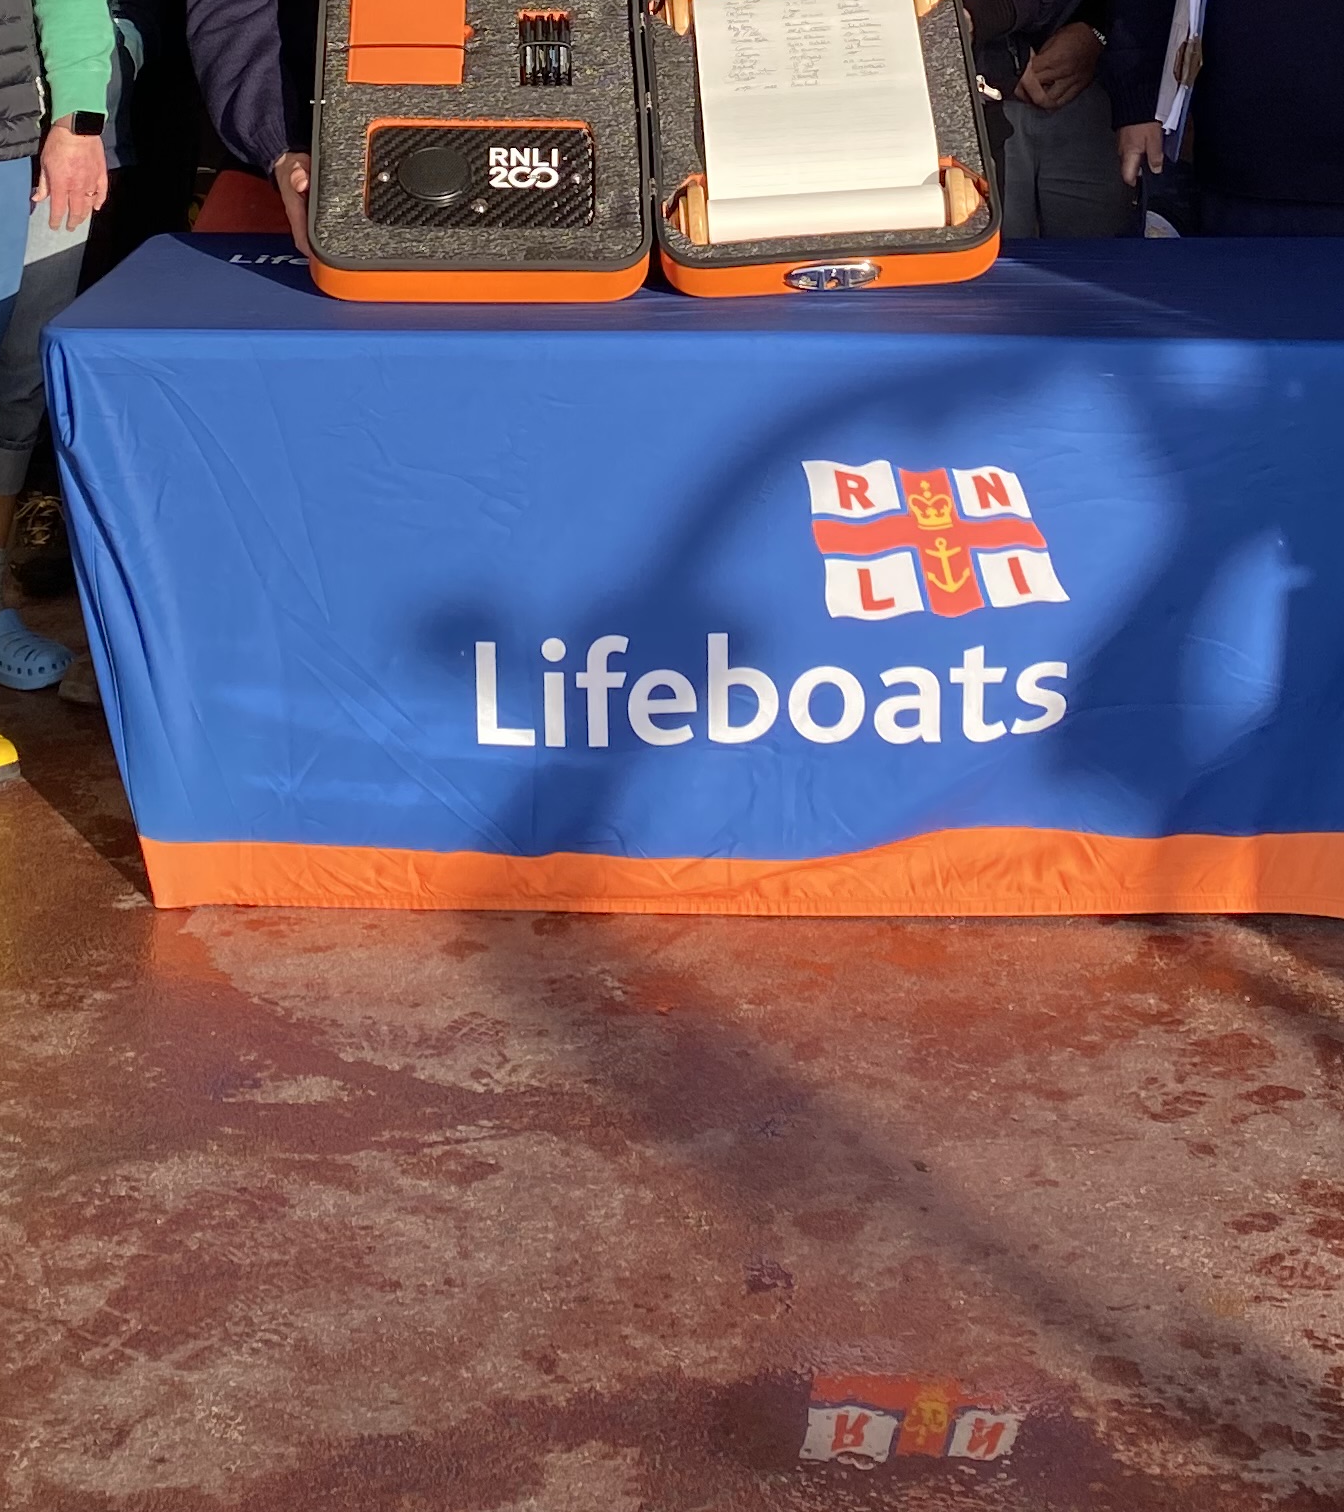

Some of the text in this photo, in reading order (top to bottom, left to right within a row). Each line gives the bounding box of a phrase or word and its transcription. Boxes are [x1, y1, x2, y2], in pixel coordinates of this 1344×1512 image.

[489, 147, 559, 167] RNLI
[489, 166, 559, 188] 200
[833, 470, 1012, 511] R N
[856, 568, 895, 611] L
[475, 633, 1068, 748] Lifeboats
